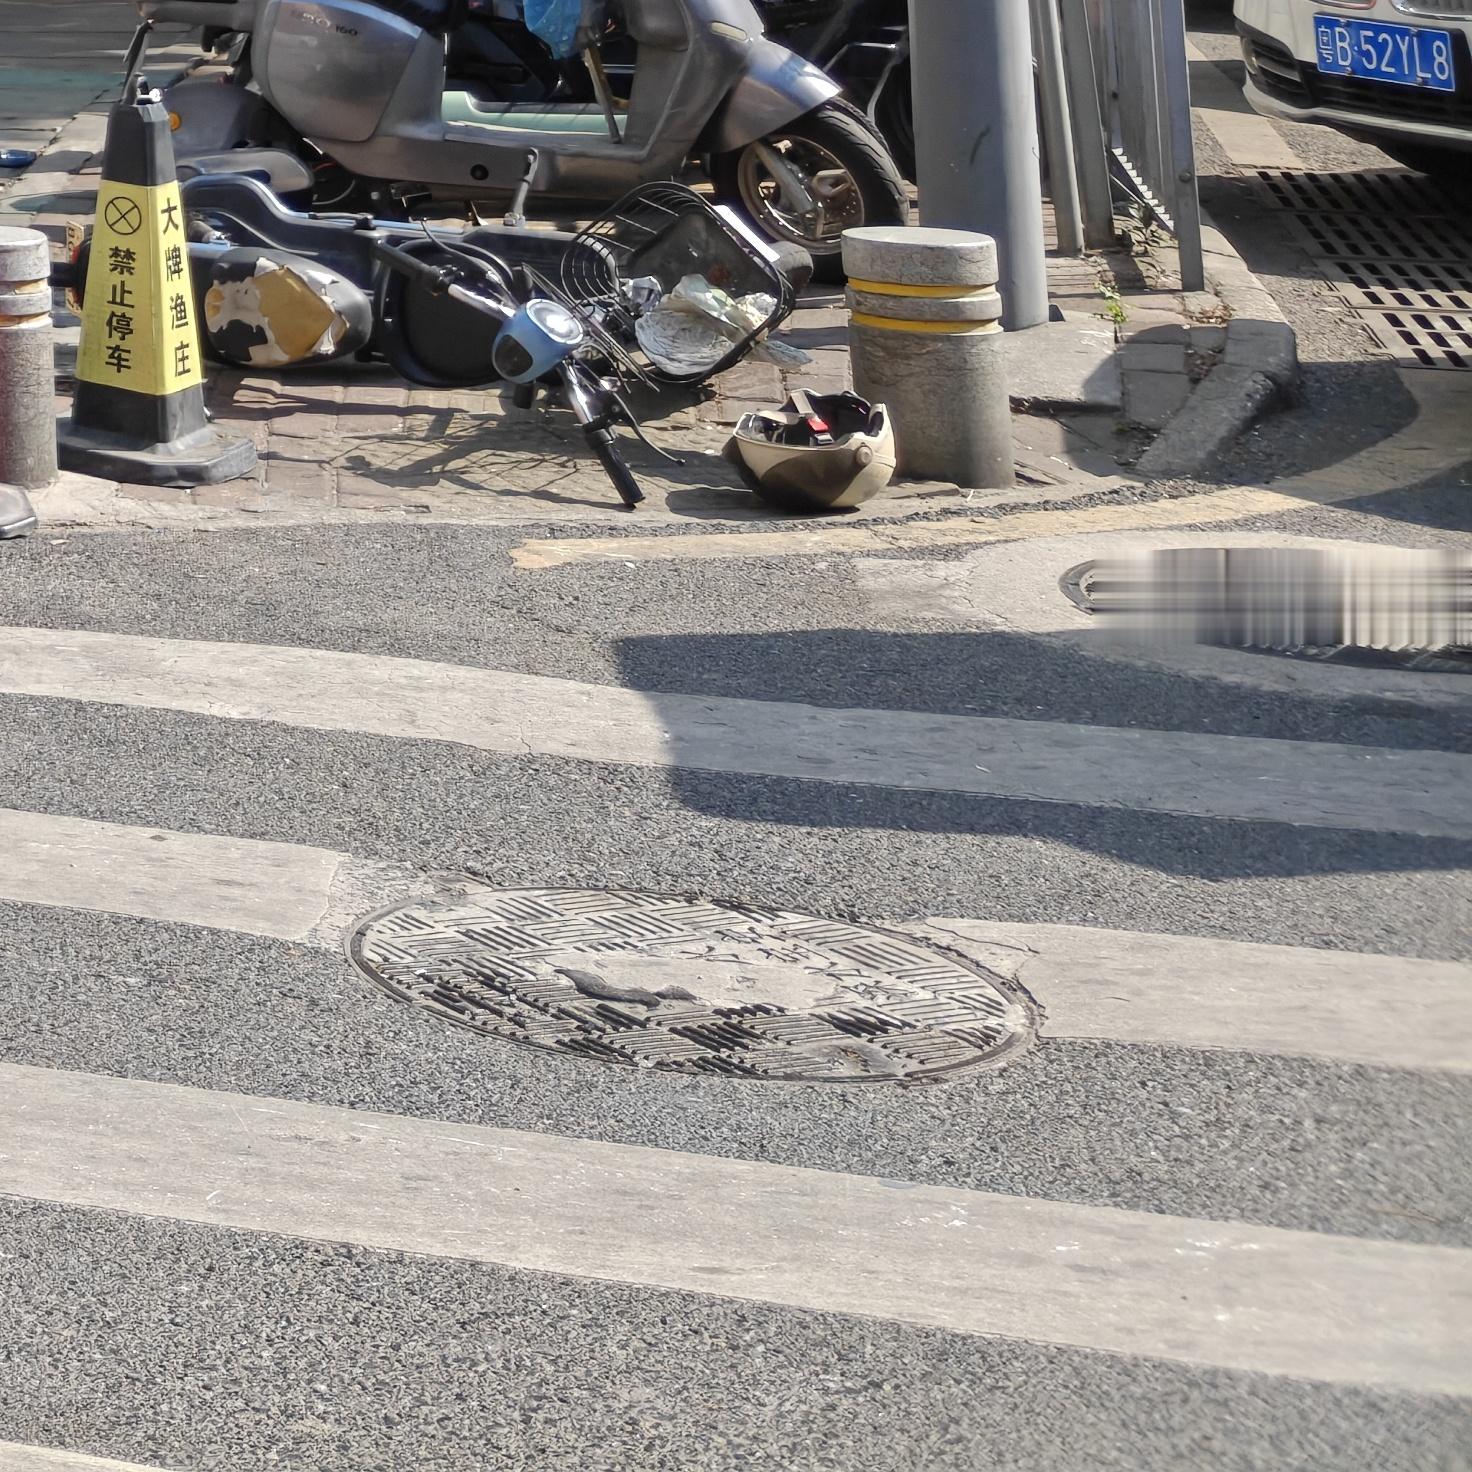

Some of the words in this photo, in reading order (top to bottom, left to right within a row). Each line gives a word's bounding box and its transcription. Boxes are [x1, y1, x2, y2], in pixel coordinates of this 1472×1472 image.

[1317, 25, 1451, 82] 粤B·52YL8
[104, 244, 137, 374] 禁止停车
[160, 196, 192, 379] 大牌渔庄
